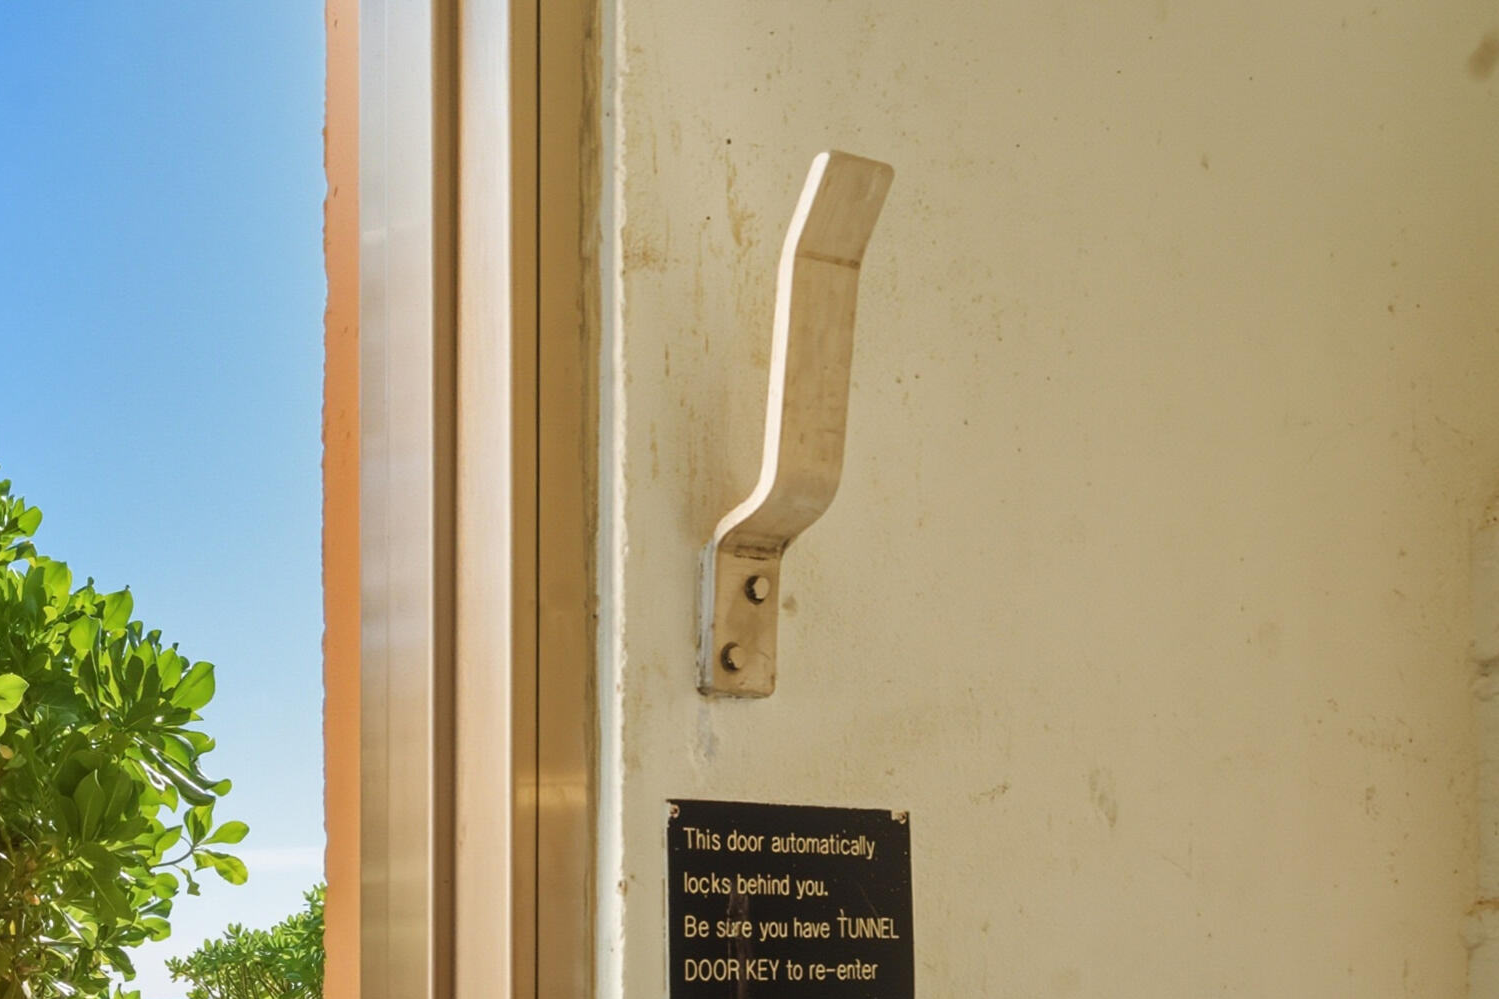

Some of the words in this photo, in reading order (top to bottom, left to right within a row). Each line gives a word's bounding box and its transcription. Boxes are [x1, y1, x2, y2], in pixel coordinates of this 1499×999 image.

[683, 827, 720, 851] This
[727, 830, 764, 852] door
[771, 833, 875, 859] automatically
[684, 872, 731, 895] locks
[737, 874, 789, 896] behind
[796, 880, 829, 899] you.
[684, 916, 709, 937] Be
[716, 921, 752, 937] sure
[760, 921, 788, 941] you
[794, 918, 830, 938] have
[837, 916, 899, 939] TUNNEL
[684, 959, 740, 981] DOOR
[746, 959, 780, 981] KEY
[786, 960, 803, 981] to
[809, 959, 878, 981] re-enter
